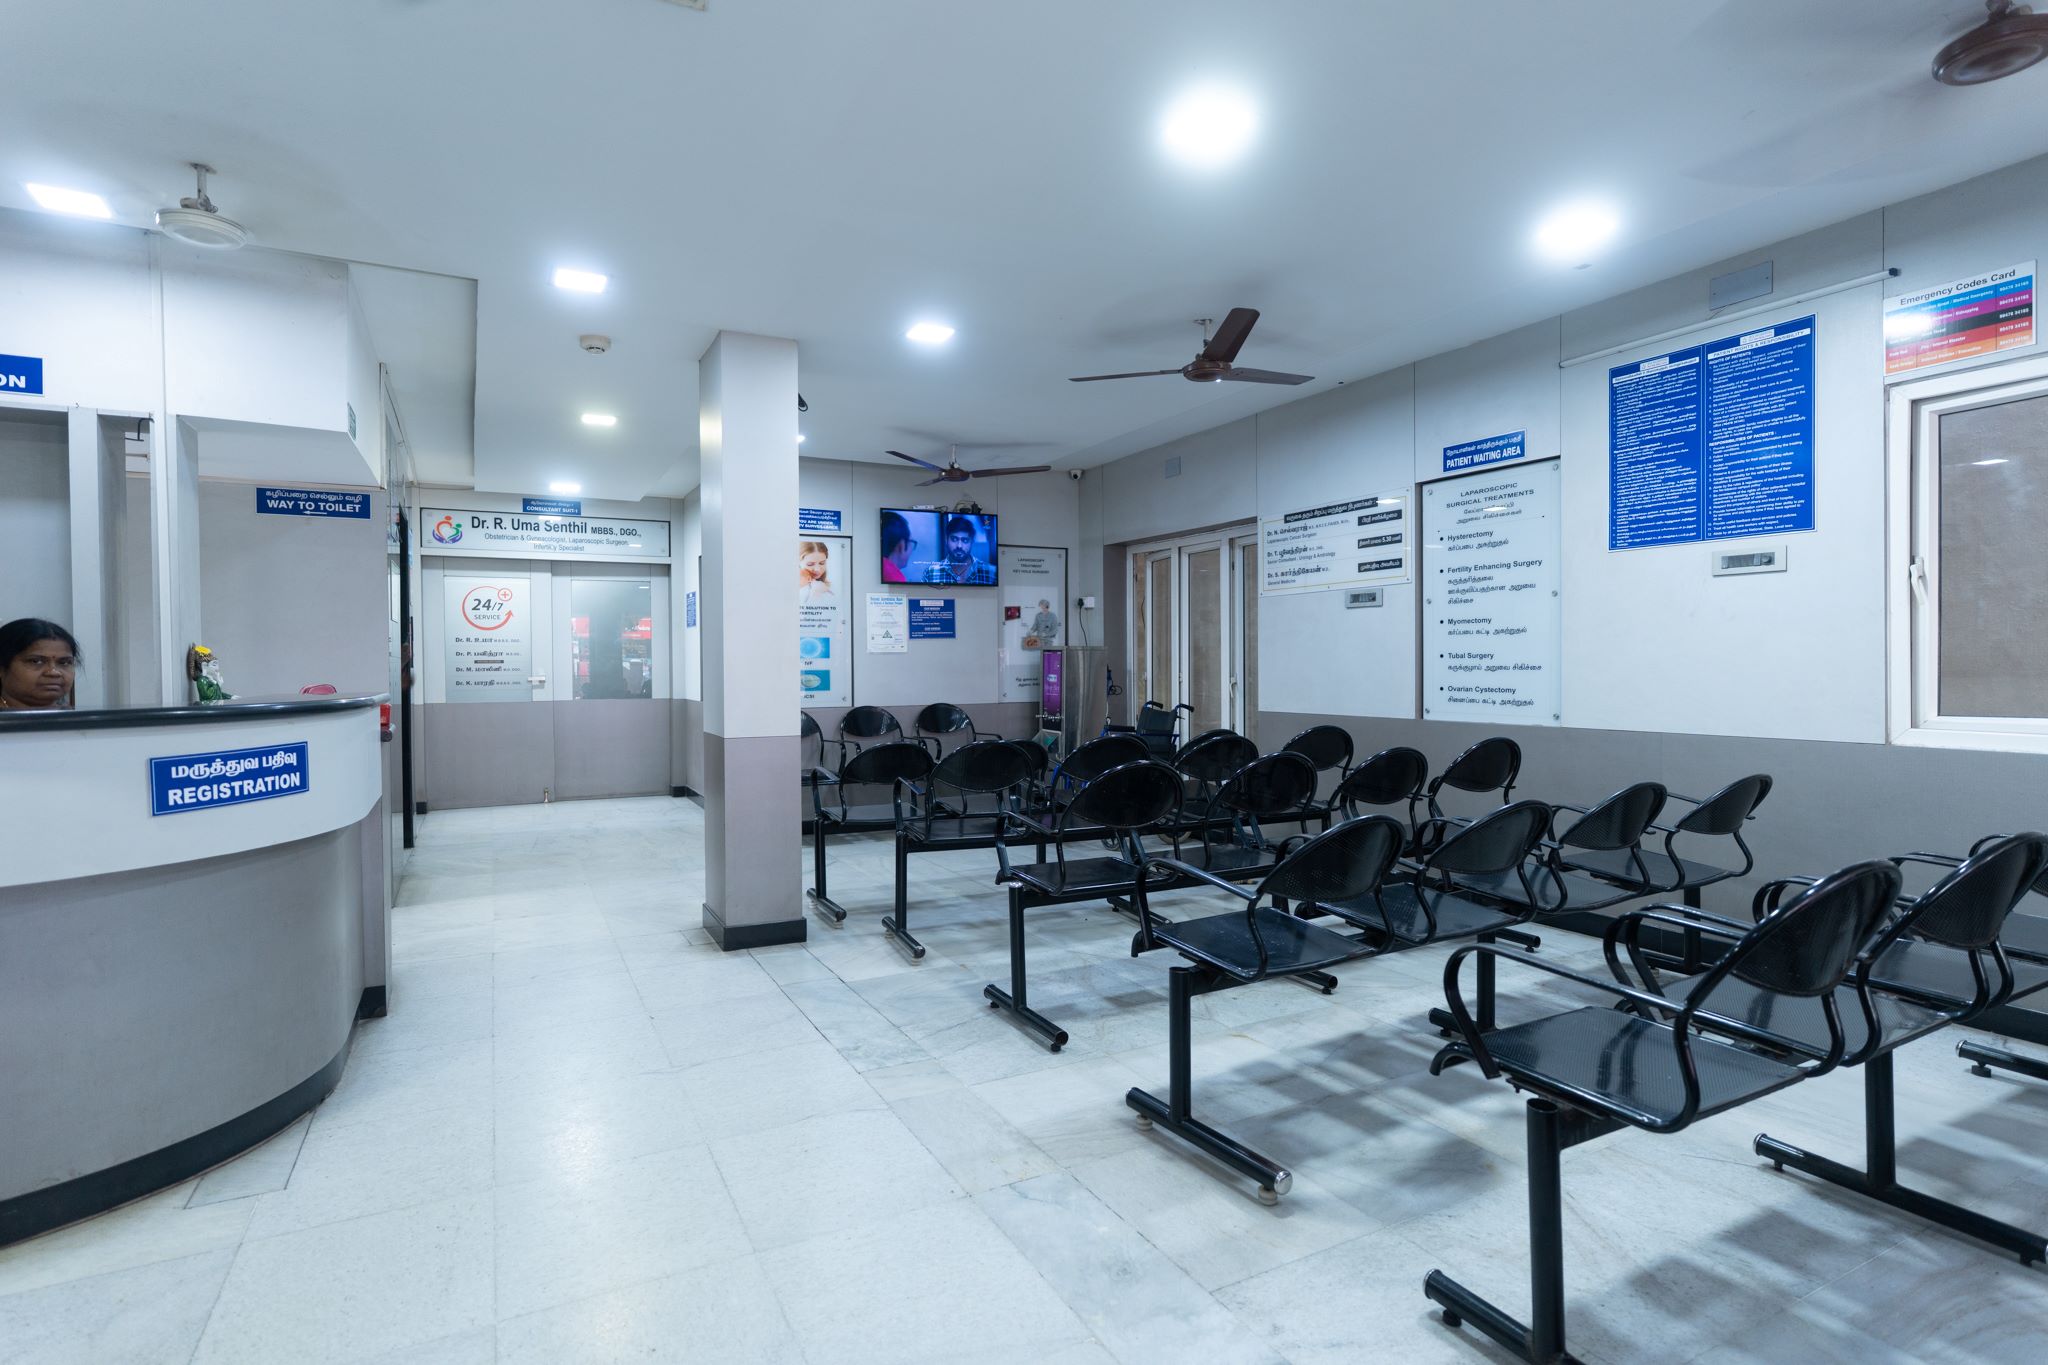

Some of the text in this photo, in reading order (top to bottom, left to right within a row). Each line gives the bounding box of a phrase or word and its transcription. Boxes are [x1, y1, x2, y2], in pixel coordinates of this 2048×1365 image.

[1900, 287, 1952, 306] Emergency
[1956, 277, 1987, 290] Codes
[1990, 269, 2015, 281] Card
[1713, 348, 1732, 358] PATIENT
[1734, 342, 1753, 352] RIGHTS
[1759, 329, 1804, 345] RESPONSIBILITY
[1446, 446, 1521, 468] PATIENT WAITING AREA
[266, 490, 308, 500] கழிப்பறை
[310, 493, 343, 501] செல்லும்
[1460, 482, 1518, 497] LAPAROSCOPIC
[267, 500, 361, 512] WAY TO TOILET
[1446, 498, 1481, 508] SURGICAL
[1484, 489, 1534, 502] TREATMENTS
[471, 516, 489, 529] Dr.
[494, 517, 507, 530] R.
[512, 519, 540, 532] Uma
[544, 520, 587, 534] Senthil
[591, 526, 618, 537] MBBS.,
[485, 532, 519, 541] Obstetrician
[568, 537, 604, 546] Laparoscopic
[1448, 530, 1494, 542] Hysterectomy
[1474, 562, 1511, 571] Enhancing
[1513, 560, 1542, 568] Surgery
[472, 598, 503, 611] 24/7
[1475, 686, 1516, 694] Cystectomy
[171, 751, 297, 780] மருத்துவ பதிவு
[168, 772, 300, 806] REGISTRATION
